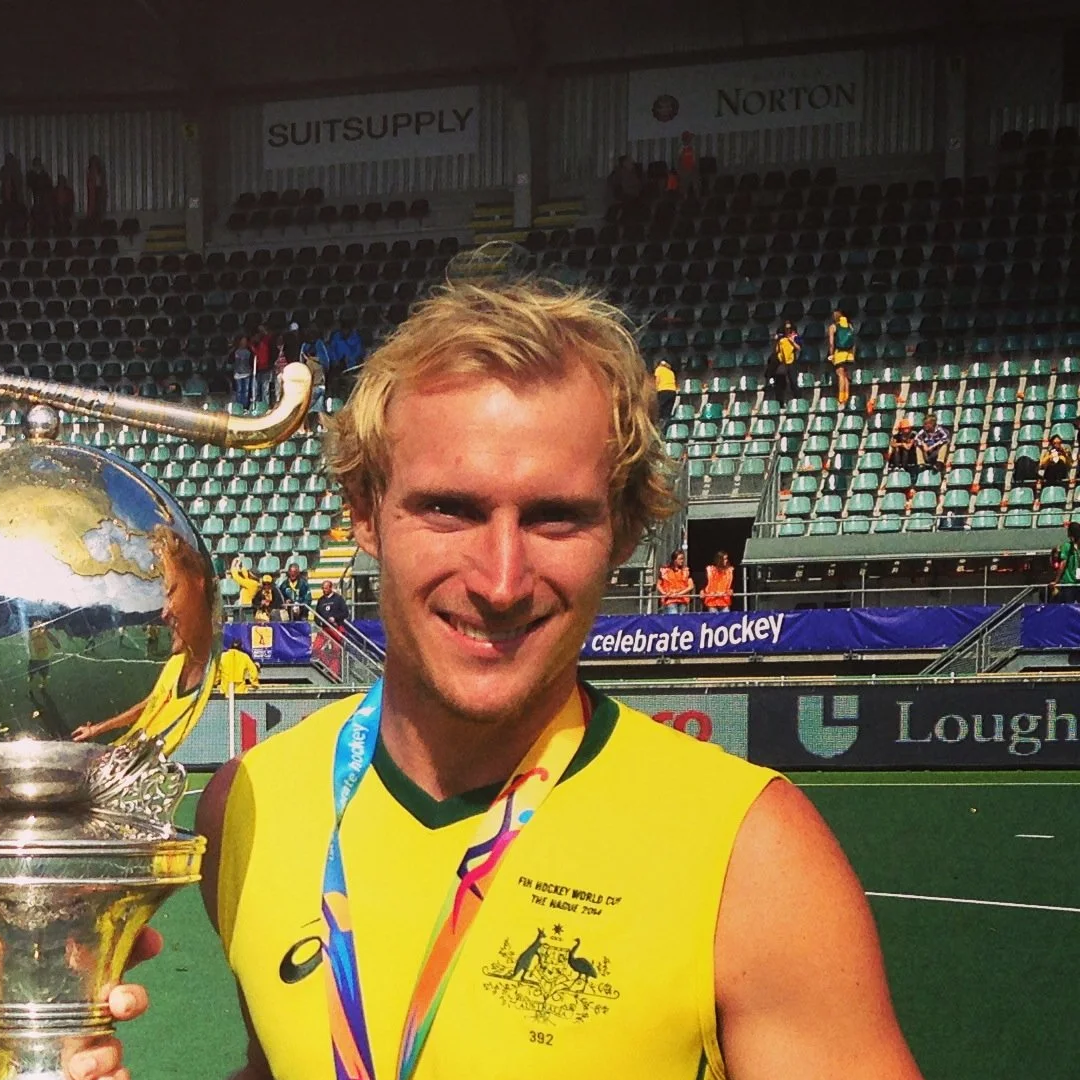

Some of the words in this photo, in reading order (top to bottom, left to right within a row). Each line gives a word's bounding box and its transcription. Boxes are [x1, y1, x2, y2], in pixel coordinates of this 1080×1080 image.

[715, 82, 857, 118] NORTON
[268, 107, 474, 148] SUITSUPPLY
[591, 625, 695, 652] celebrate
[699, 613, 784, 648] hockey
[348, 722, 369, 772] hockey
[895, 699, 1079, 756] Lough
[535, 881, 571, 896] HOCKEY
[572, 889, 604, 904] WORLD
[529, 1030, 554, 1046] 392
